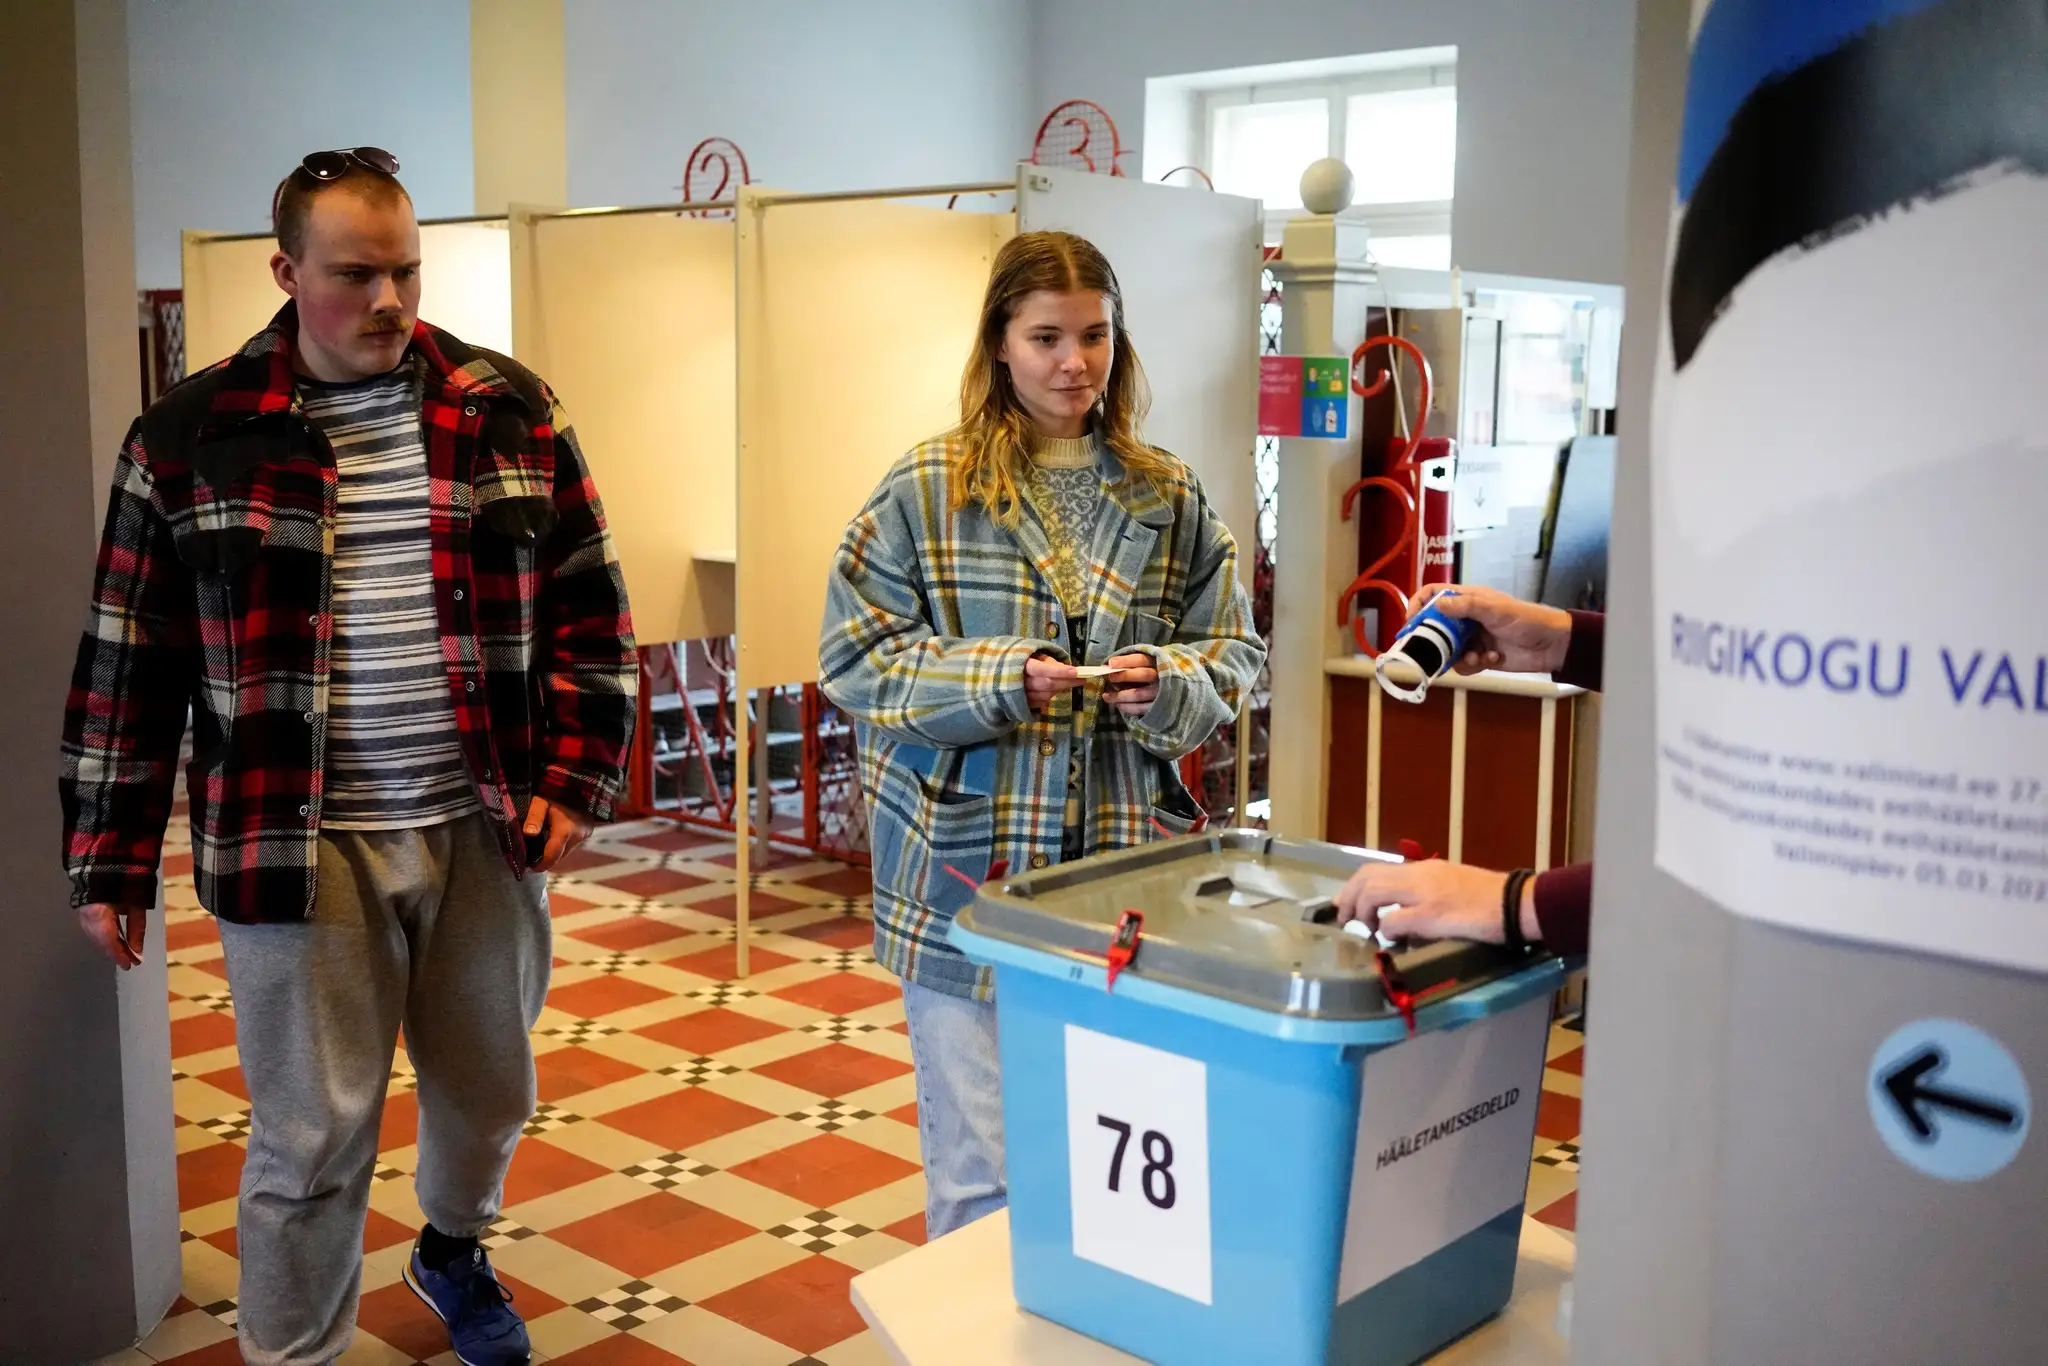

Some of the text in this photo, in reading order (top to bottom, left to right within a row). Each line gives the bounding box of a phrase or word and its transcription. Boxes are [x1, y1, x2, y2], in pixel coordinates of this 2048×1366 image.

[1940, 647, 2048, 712] VAL
[1097, 1113, 1176, 1209] 78
[1376, 1088, 1520, 1171] HÄÄLETAMISSEDELID
